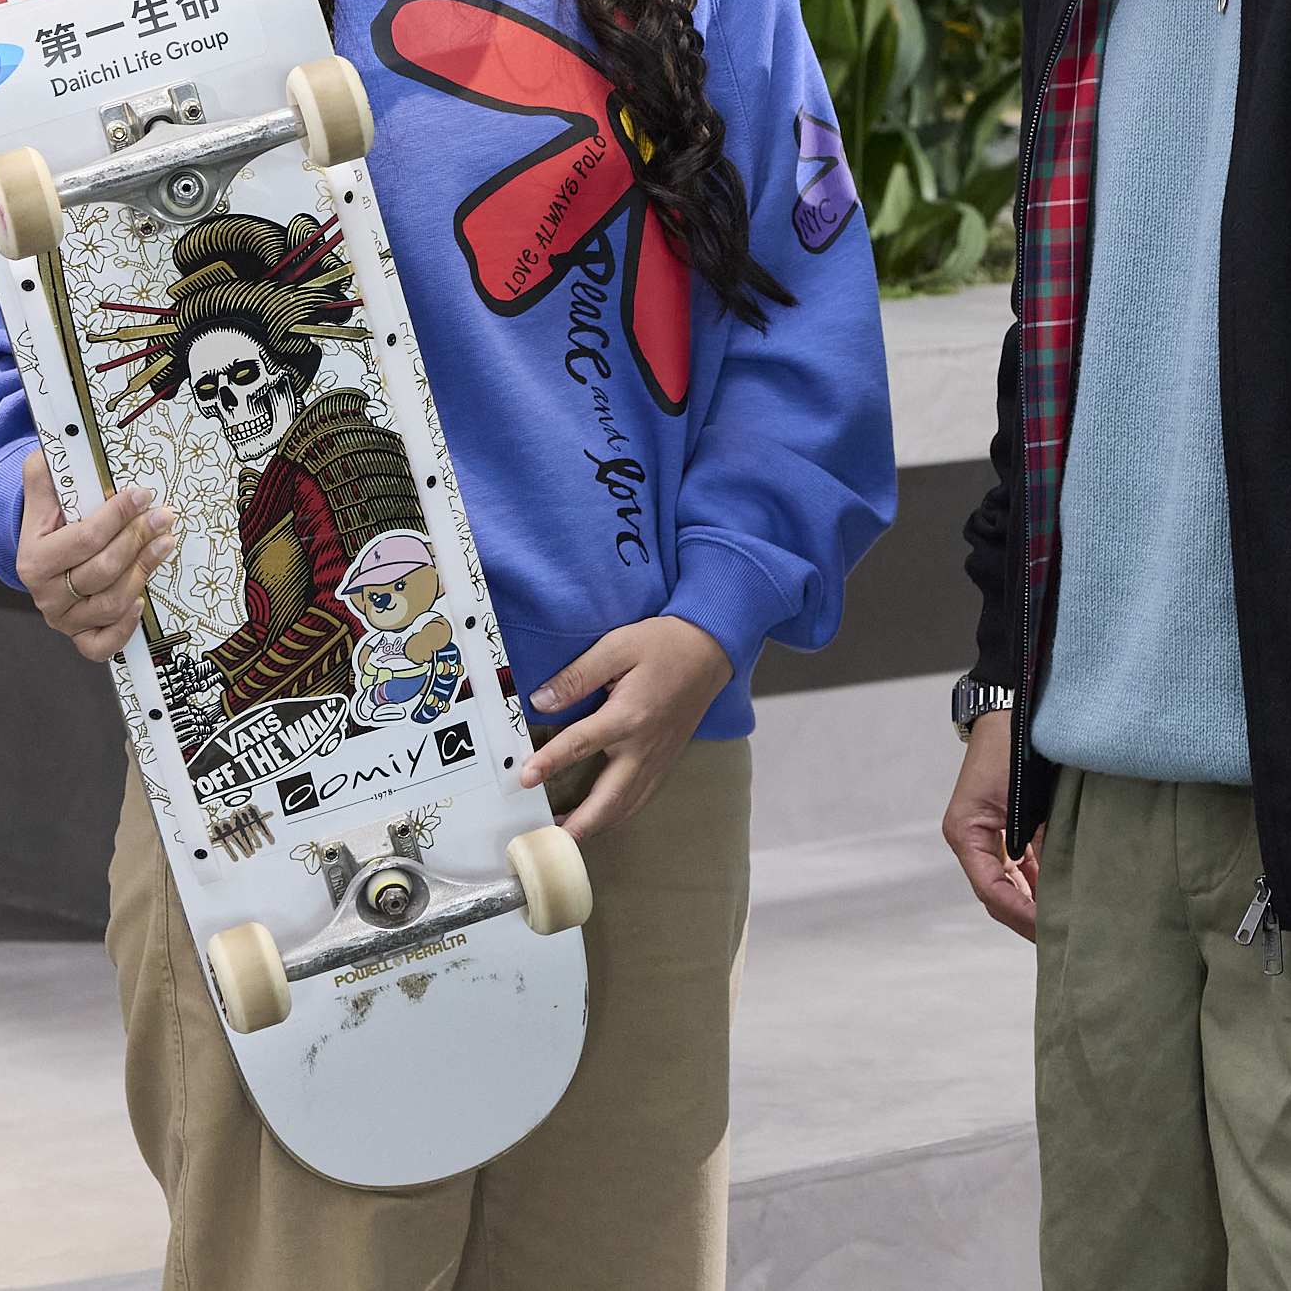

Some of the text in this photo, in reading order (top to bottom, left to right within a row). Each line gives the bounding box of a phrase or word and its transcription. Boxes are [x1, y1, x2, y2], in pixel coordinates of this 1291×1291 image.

[50, 30, 229, 98] Daiichi Life Group
[535, 177, 579, 250] ALWAYS
[572, 135, 607, 179] POLO
[799, 198, 838, 240] NYC
[591, 385, 630, 453] and
[214, 706, 282, 757] VANS
[233, 735, 290, 780] THE
[374, 788, 394, 801] 1978
[333, 933, 467, 988] POWELL PERALTA
